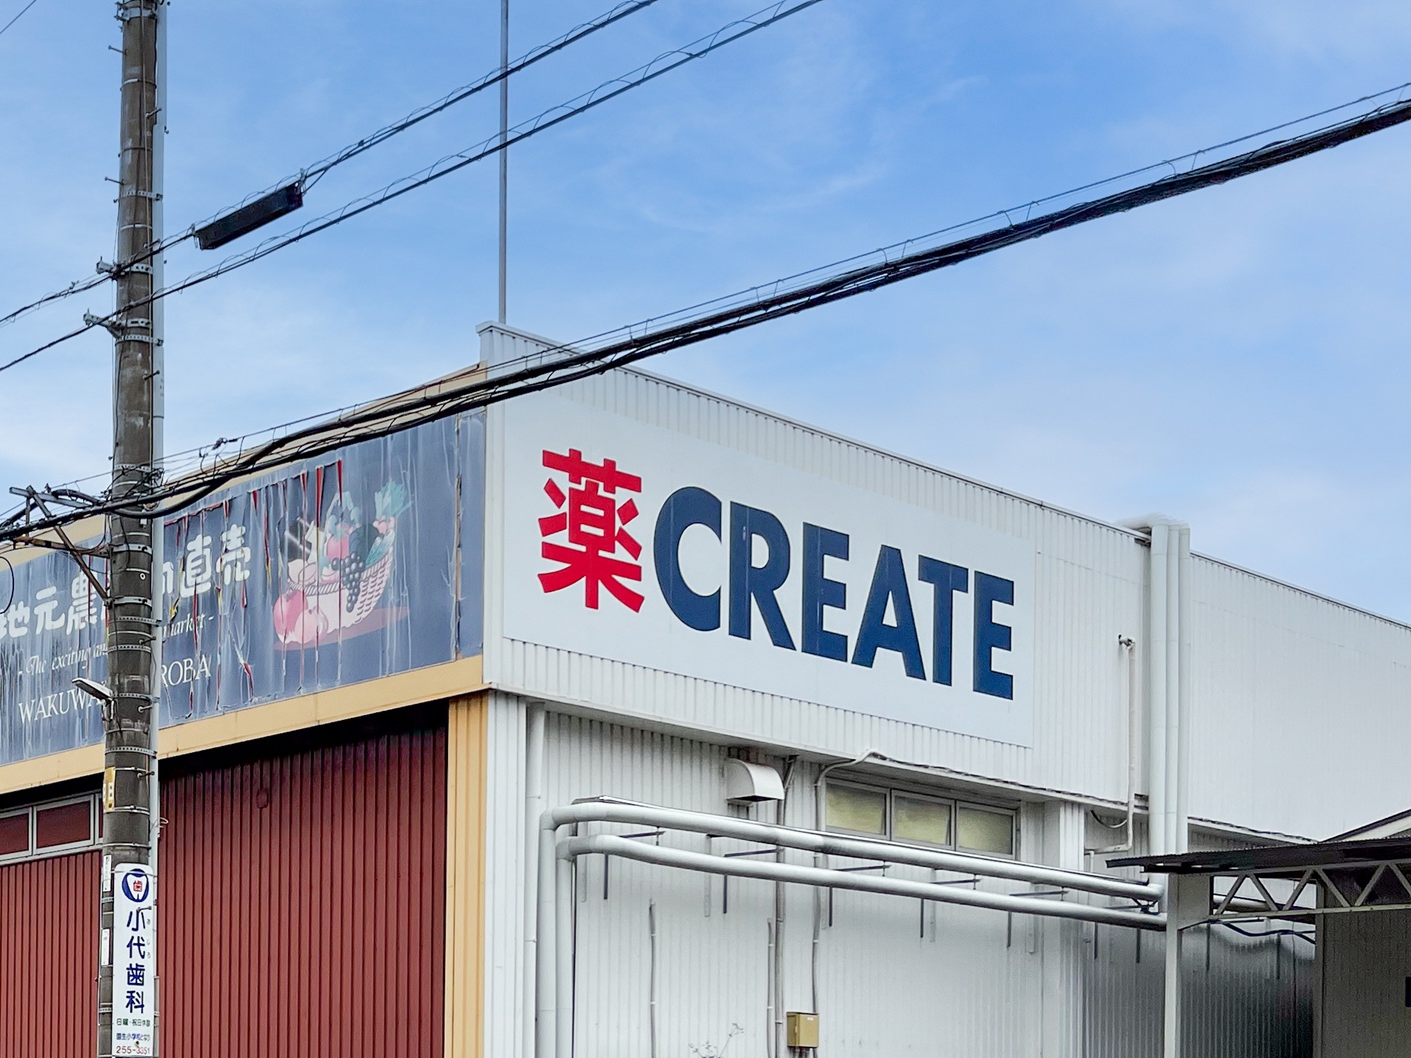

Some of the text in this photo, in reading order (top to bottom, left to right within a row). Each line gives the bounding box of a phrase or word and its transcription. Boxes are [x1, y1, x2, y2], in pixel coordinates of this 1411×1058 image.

[538, 448, 1014, 700] 薬 CREATE
[125, 909, 146, 1014] 小代歯科
